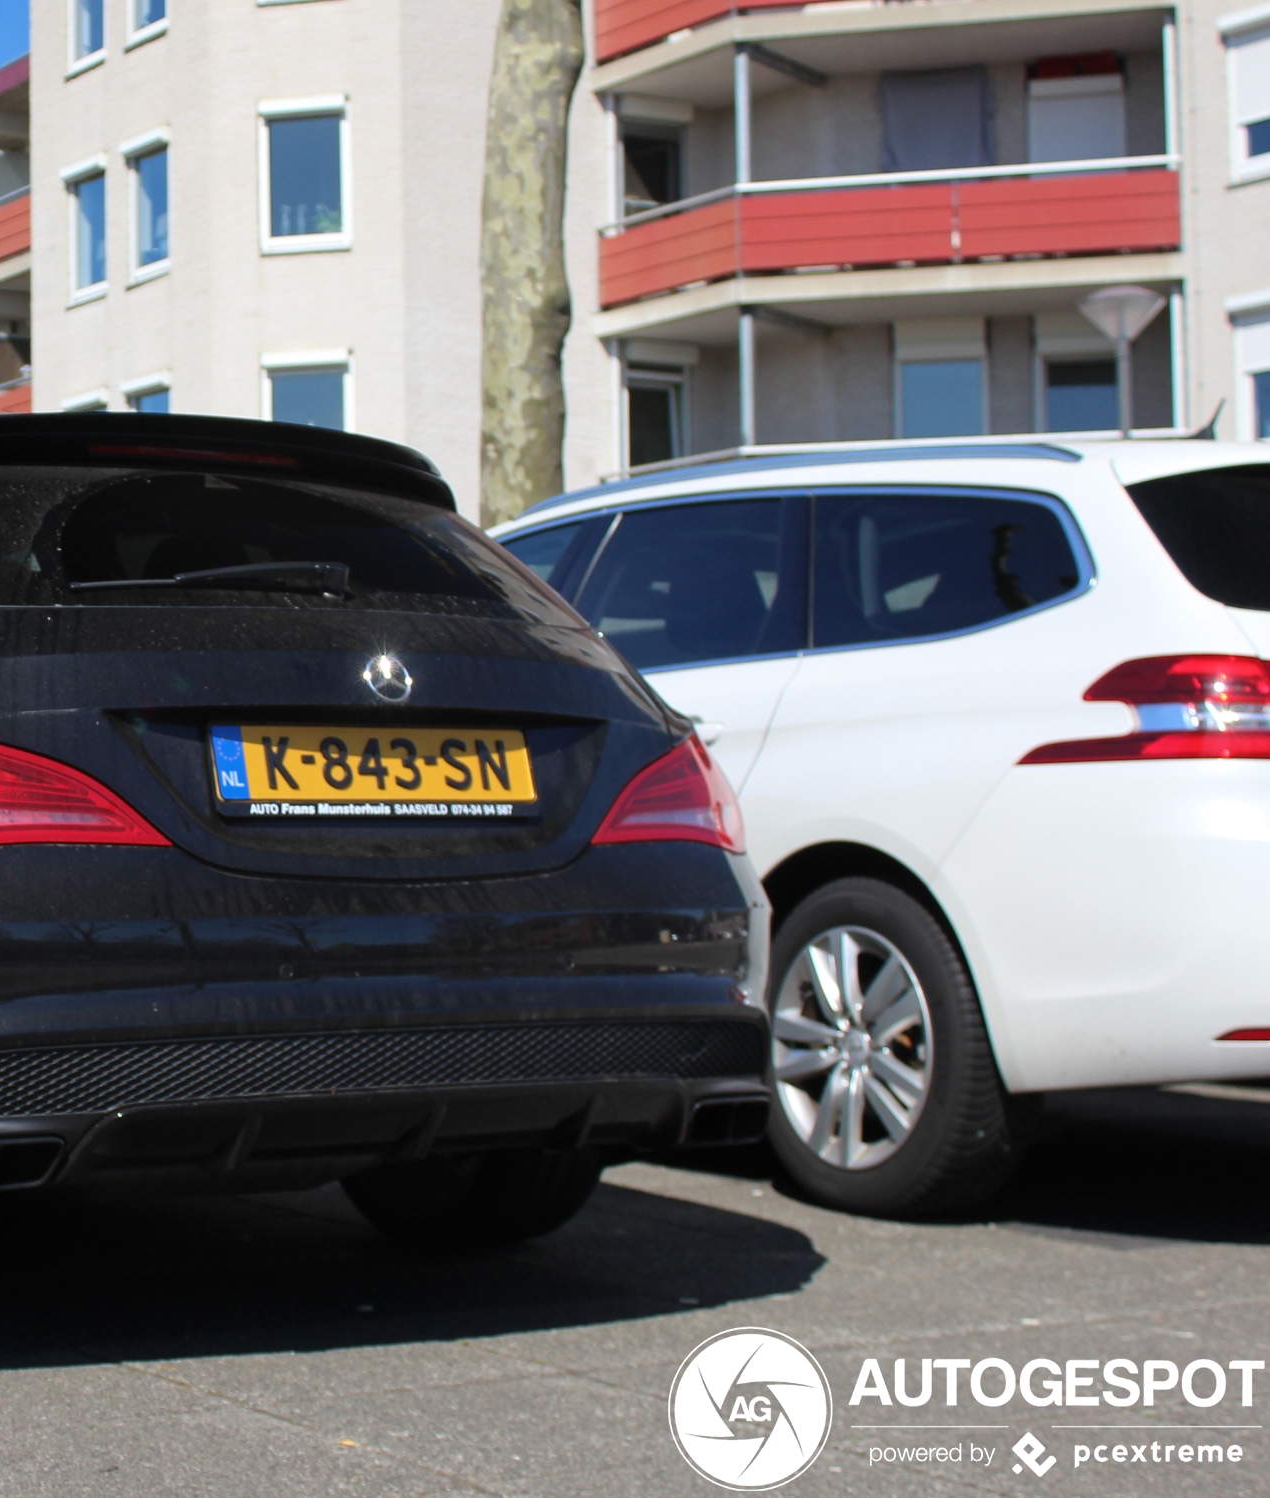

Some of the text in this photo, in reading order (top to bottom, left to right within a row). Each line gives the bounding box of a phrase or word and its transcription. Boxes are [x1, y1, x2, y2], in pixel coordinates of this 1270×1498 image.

[261, 735, 511, 792] K-843-SN
[221, 770, 245, 788] NL
[250, 804, 279, 815] AUTO
[281, 803, 316, 815] Frans
[318, 803, 391, 815] Munsterhuis
[393, 804, 448, 816] SAASVELD
[451, 805, 483, 816] 074-34
[495, 805, 513, 816] 587
